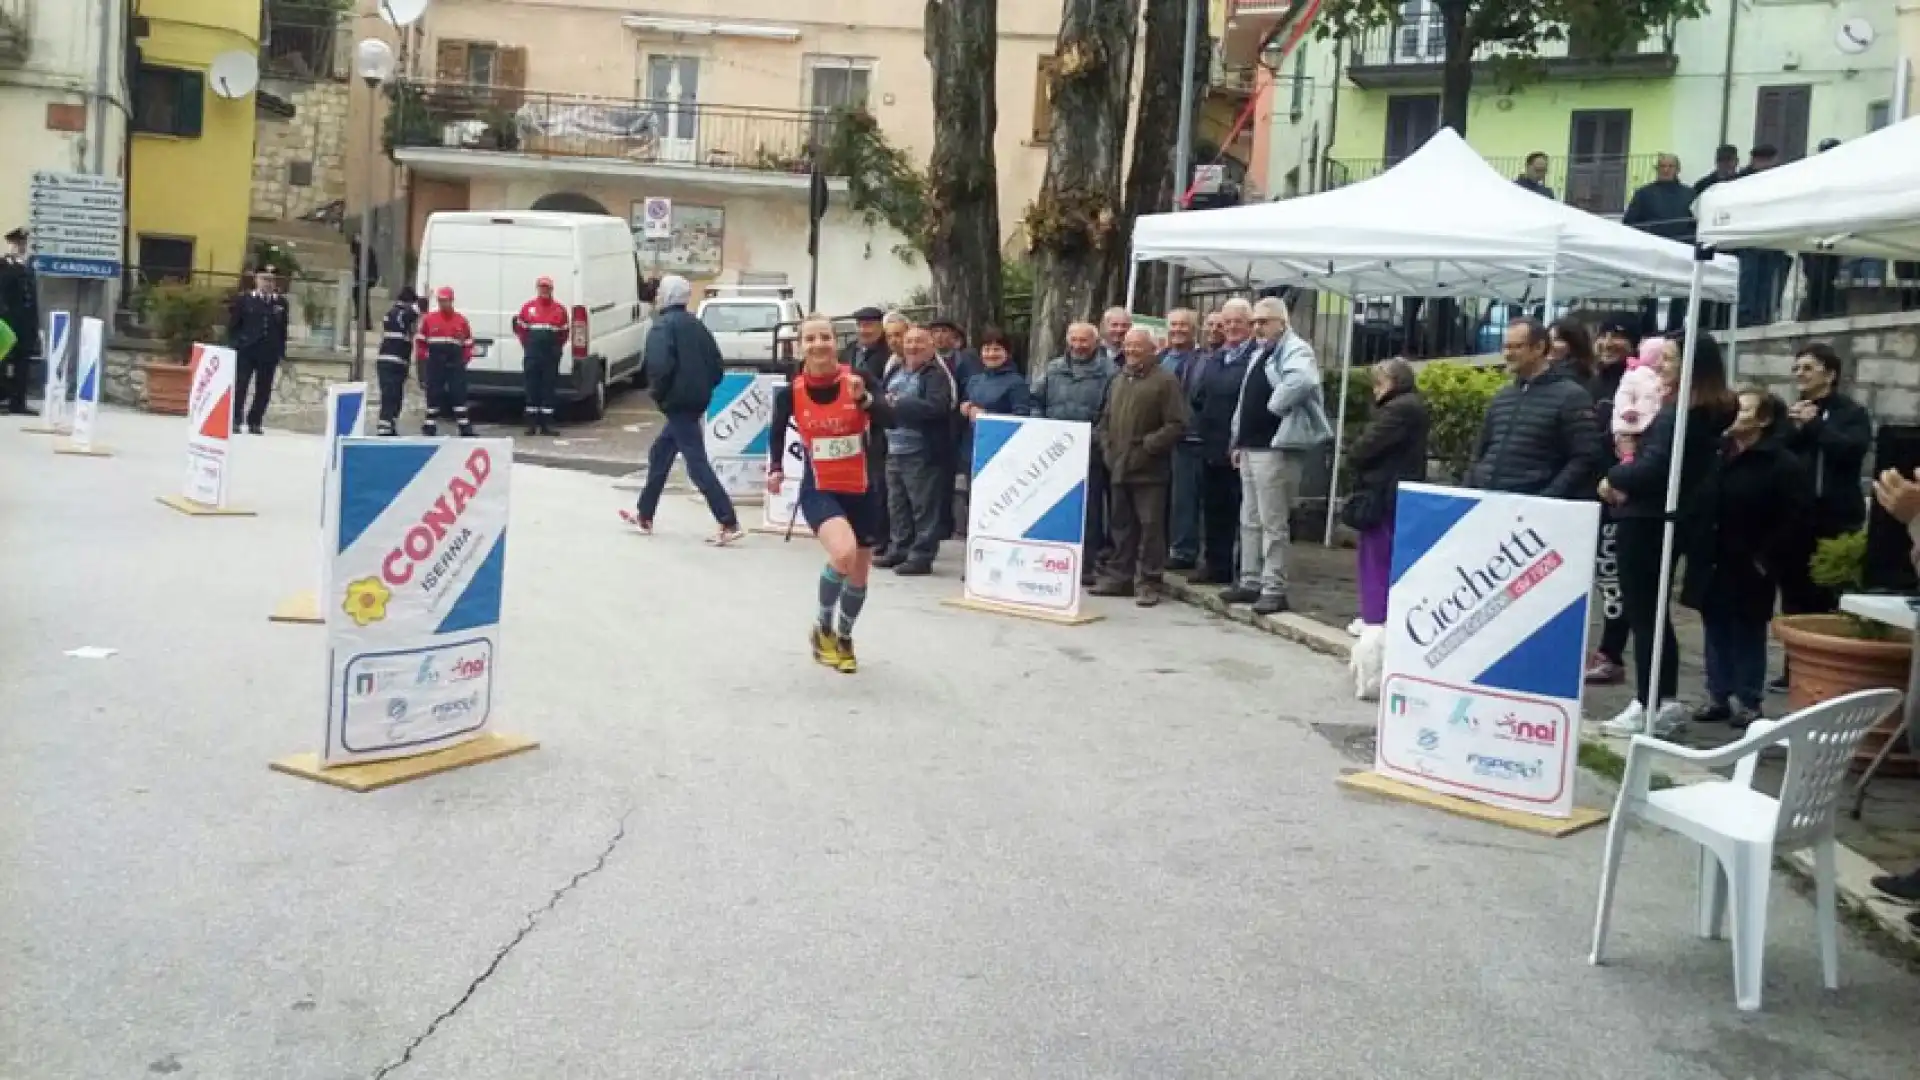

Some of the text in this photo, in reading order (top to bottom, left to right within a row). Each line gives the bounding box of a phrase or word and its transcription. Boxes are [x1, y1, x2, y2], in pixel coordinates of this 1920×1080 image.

[713, 385, 763, 441] GATE
[381, 446, 491, 586] CONAD
[421, 527, 473, 593] ISERNIA
[1406, 514, 1549, 648] Cicchetti
[1597, 523, 1622, 619] adidas
